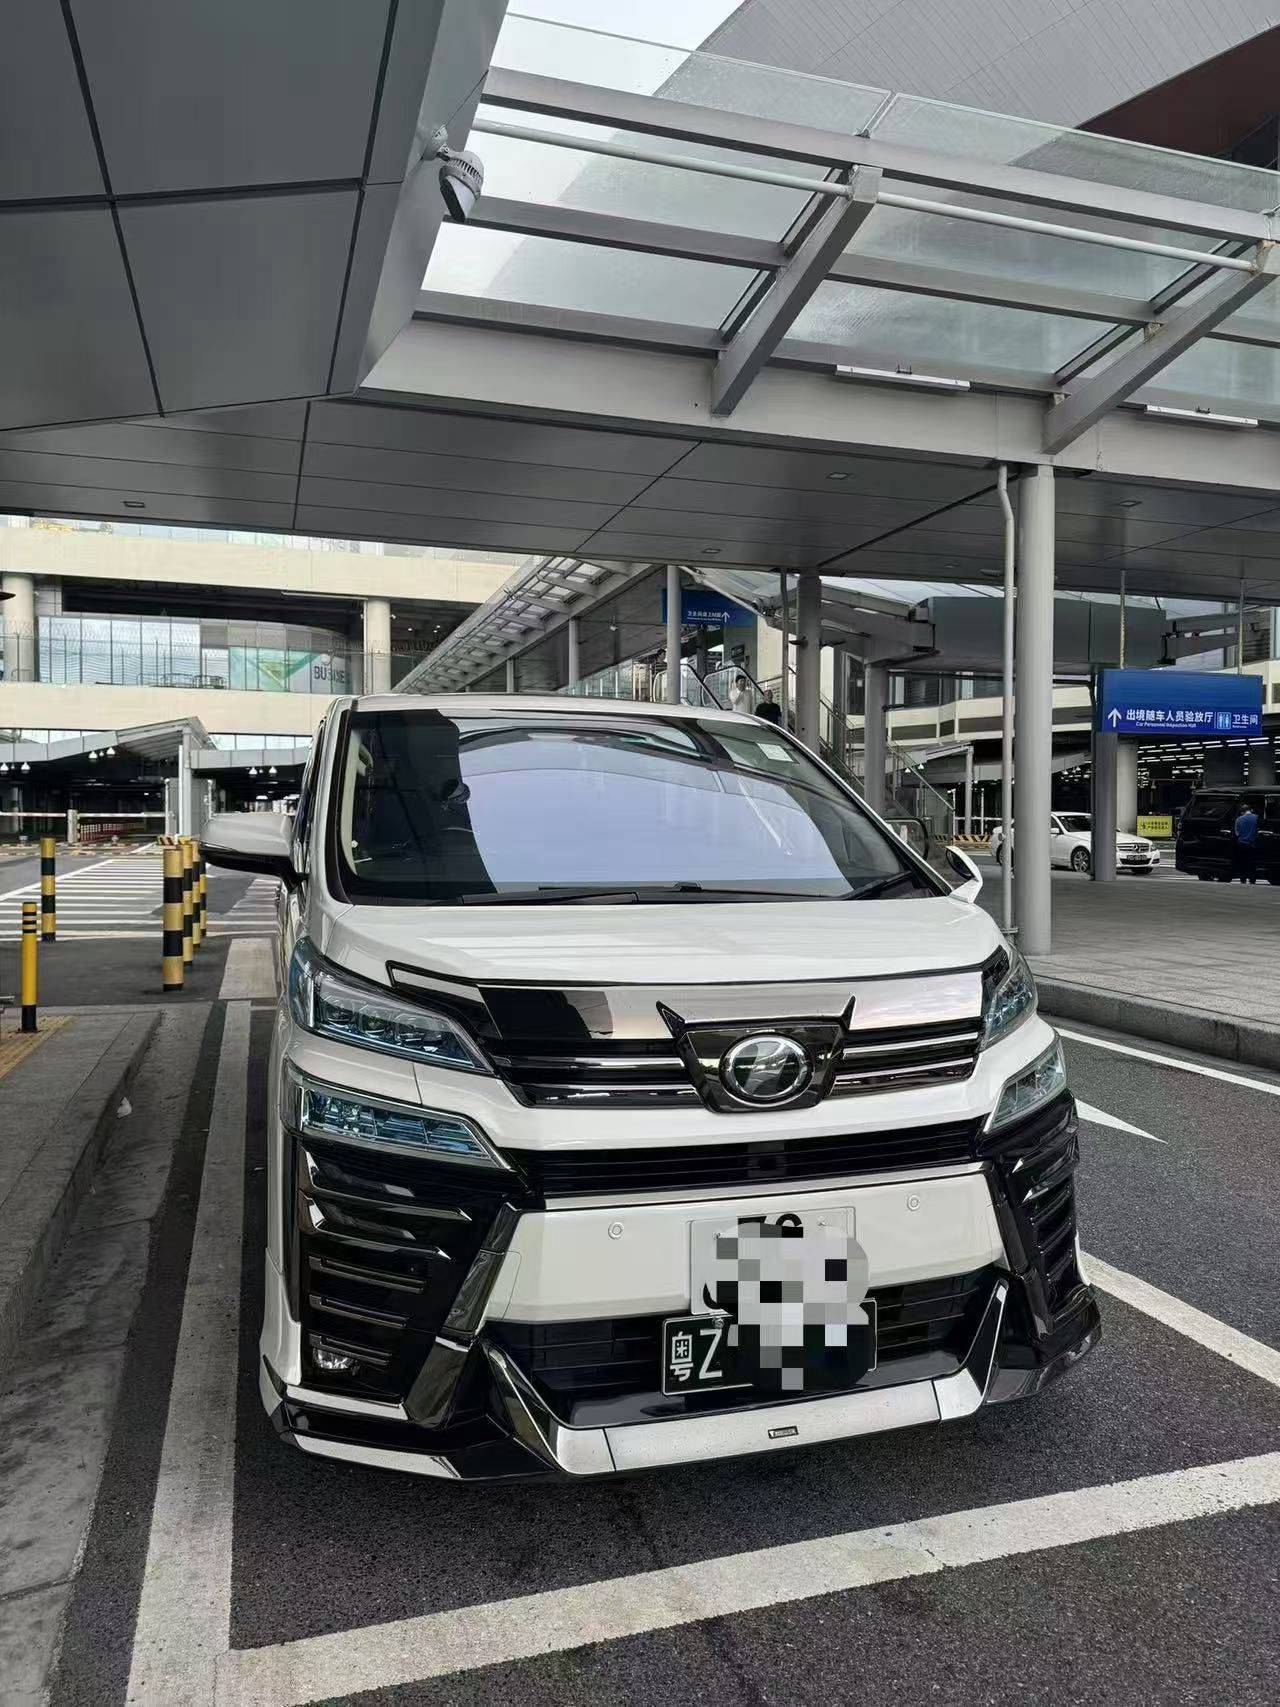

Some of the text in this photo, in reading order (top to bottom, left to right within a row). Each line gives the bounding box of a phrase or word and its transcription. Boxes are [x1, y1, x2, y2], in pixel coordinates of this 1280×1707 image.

[1126, 709, 1213, 723] 出境随车人员验放厅
[1232, 714, 1259, 725] 卫生间
